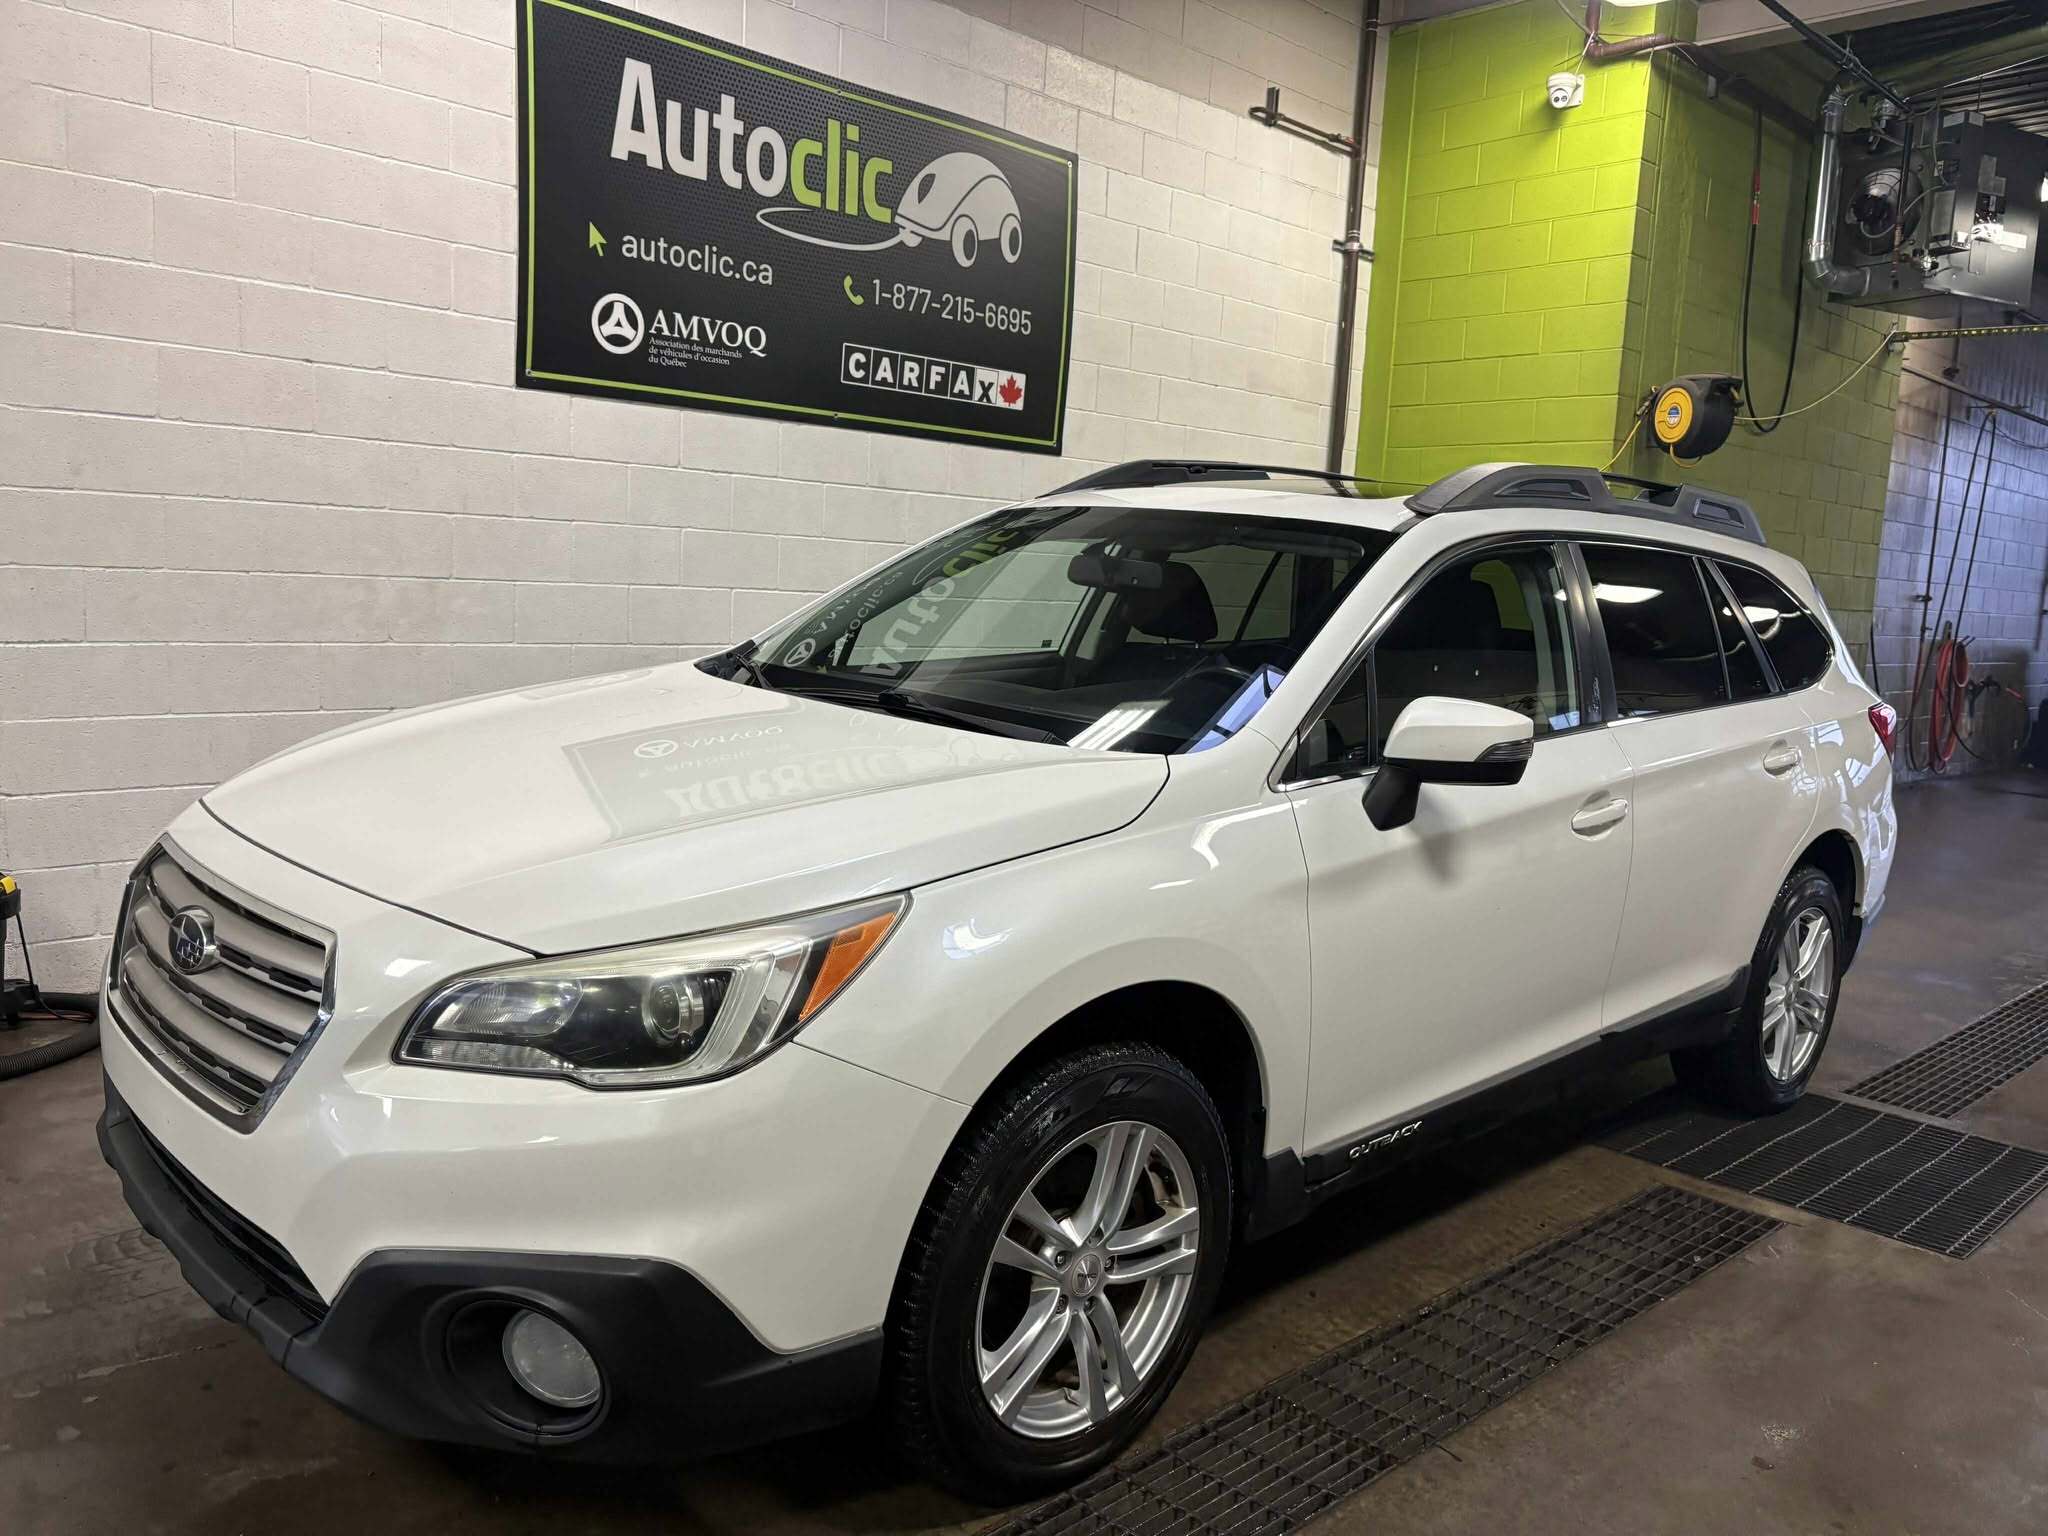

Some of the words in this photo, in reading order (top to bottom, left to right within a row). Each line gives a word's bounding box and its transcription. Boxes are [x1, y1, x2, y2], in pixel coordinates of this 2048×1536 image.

[611, 57, 893, 224] Autoclic
[621, 235, 773, 285] autoclic.ca
[873, 279, 1032, 335] 1-877-215-6695
[649, 309, 767, 357] AMVOQ
[649, 337, 690, 350] Association
[691, 344, 704, 353] des
[705, 348, 743, 359] marchands
[649, 346, 659, 355] de
[660, 348, 693, 360] véhicules
[648, 355, 659, 363] du
[660, 356, 687, 368] Québec
[849, 352, 995, 403] CARFAX
